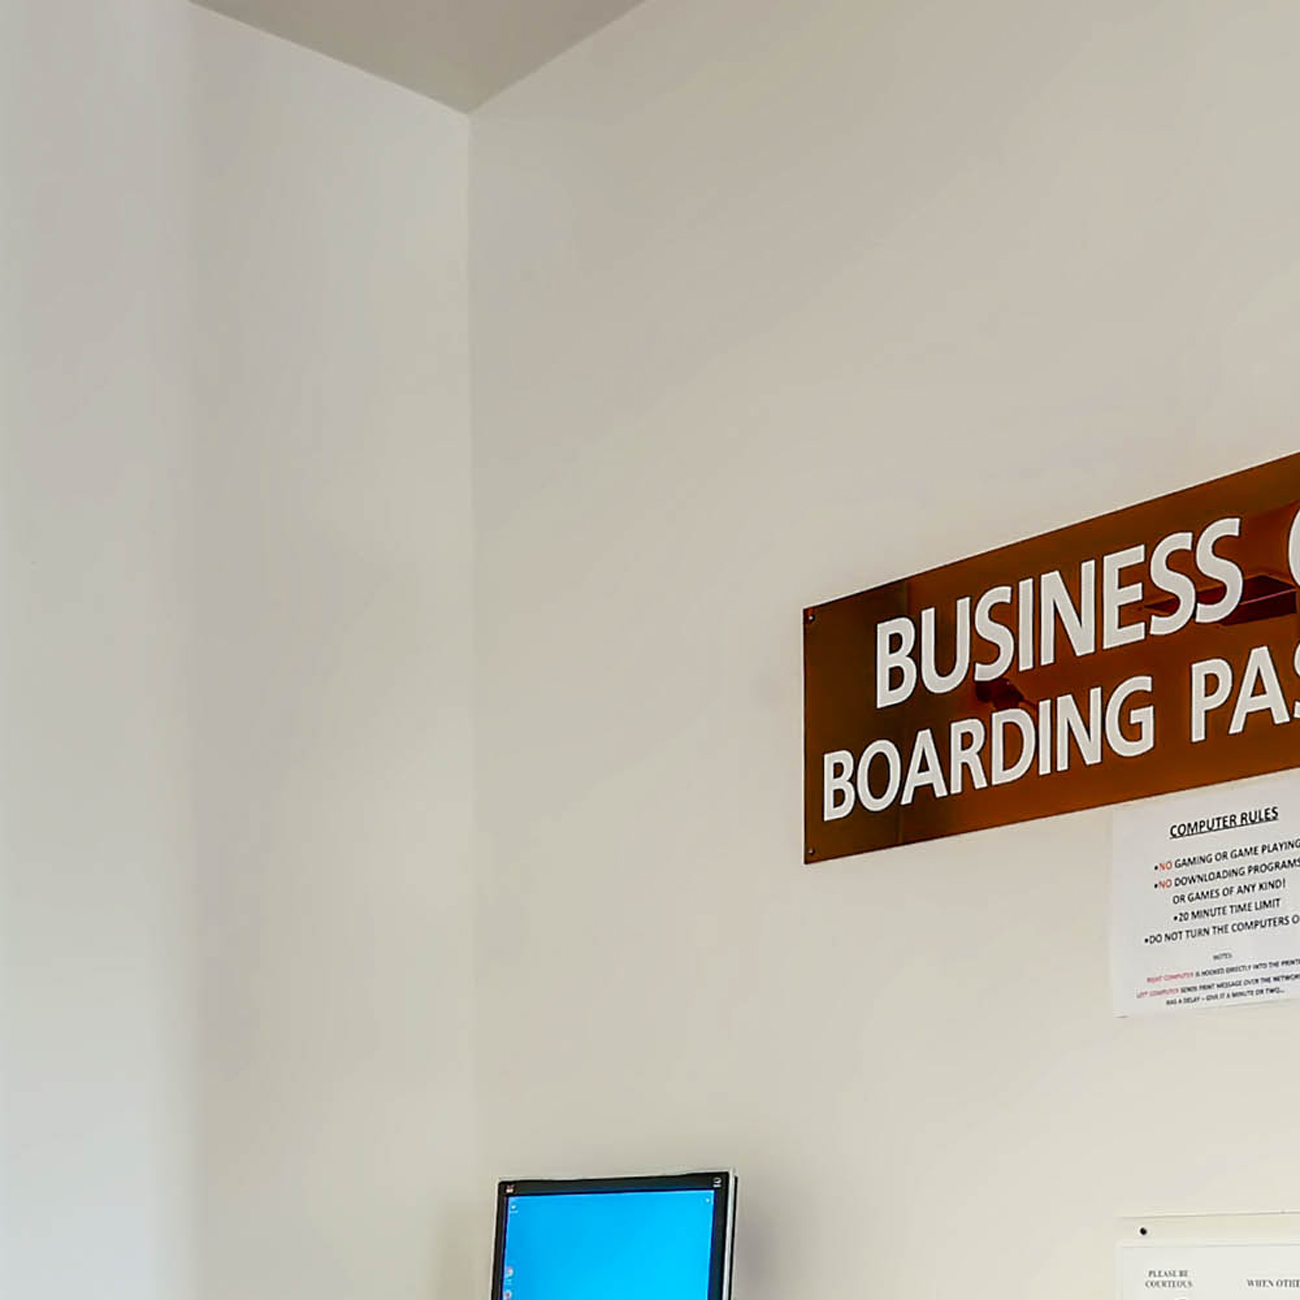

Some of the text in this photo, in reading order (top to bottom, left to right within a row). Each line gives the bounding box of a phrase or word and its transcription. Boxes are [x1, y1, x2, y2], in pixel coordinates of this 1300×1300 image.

[875, 517, 1243, 709] BUSINESS
[823, 676, 1154, 822] BOARDING
[1170, 807, 1279, 839] COMPUTER RULES
[1159, 862, 1173, 871] NO
[1175, 854, 1212, 868] GAMING
[1215, 852, 1228, 861] OR
[1230, 847, 1258, 859] GAME
[1159, 880, 1172, 888] NO
[1174, 869, 1245, 887] DOWNLOADING
[1173, 879, 1286, 904] OR GAMES OF ANY KIND!
[1178, 899, 1281, 922] 20 MINUTE TIME LIMIT
[1149, 934, 1162, 944] DO
[1165, 931, 1183, 942] NOT
[1185, 927, 1210, 939] TURN
[1213, 924, 1228, 935] THE
[1231, 917, 1289, 932] COMPUTERS
[1247, 1279, 1273, 1287] WHEN
